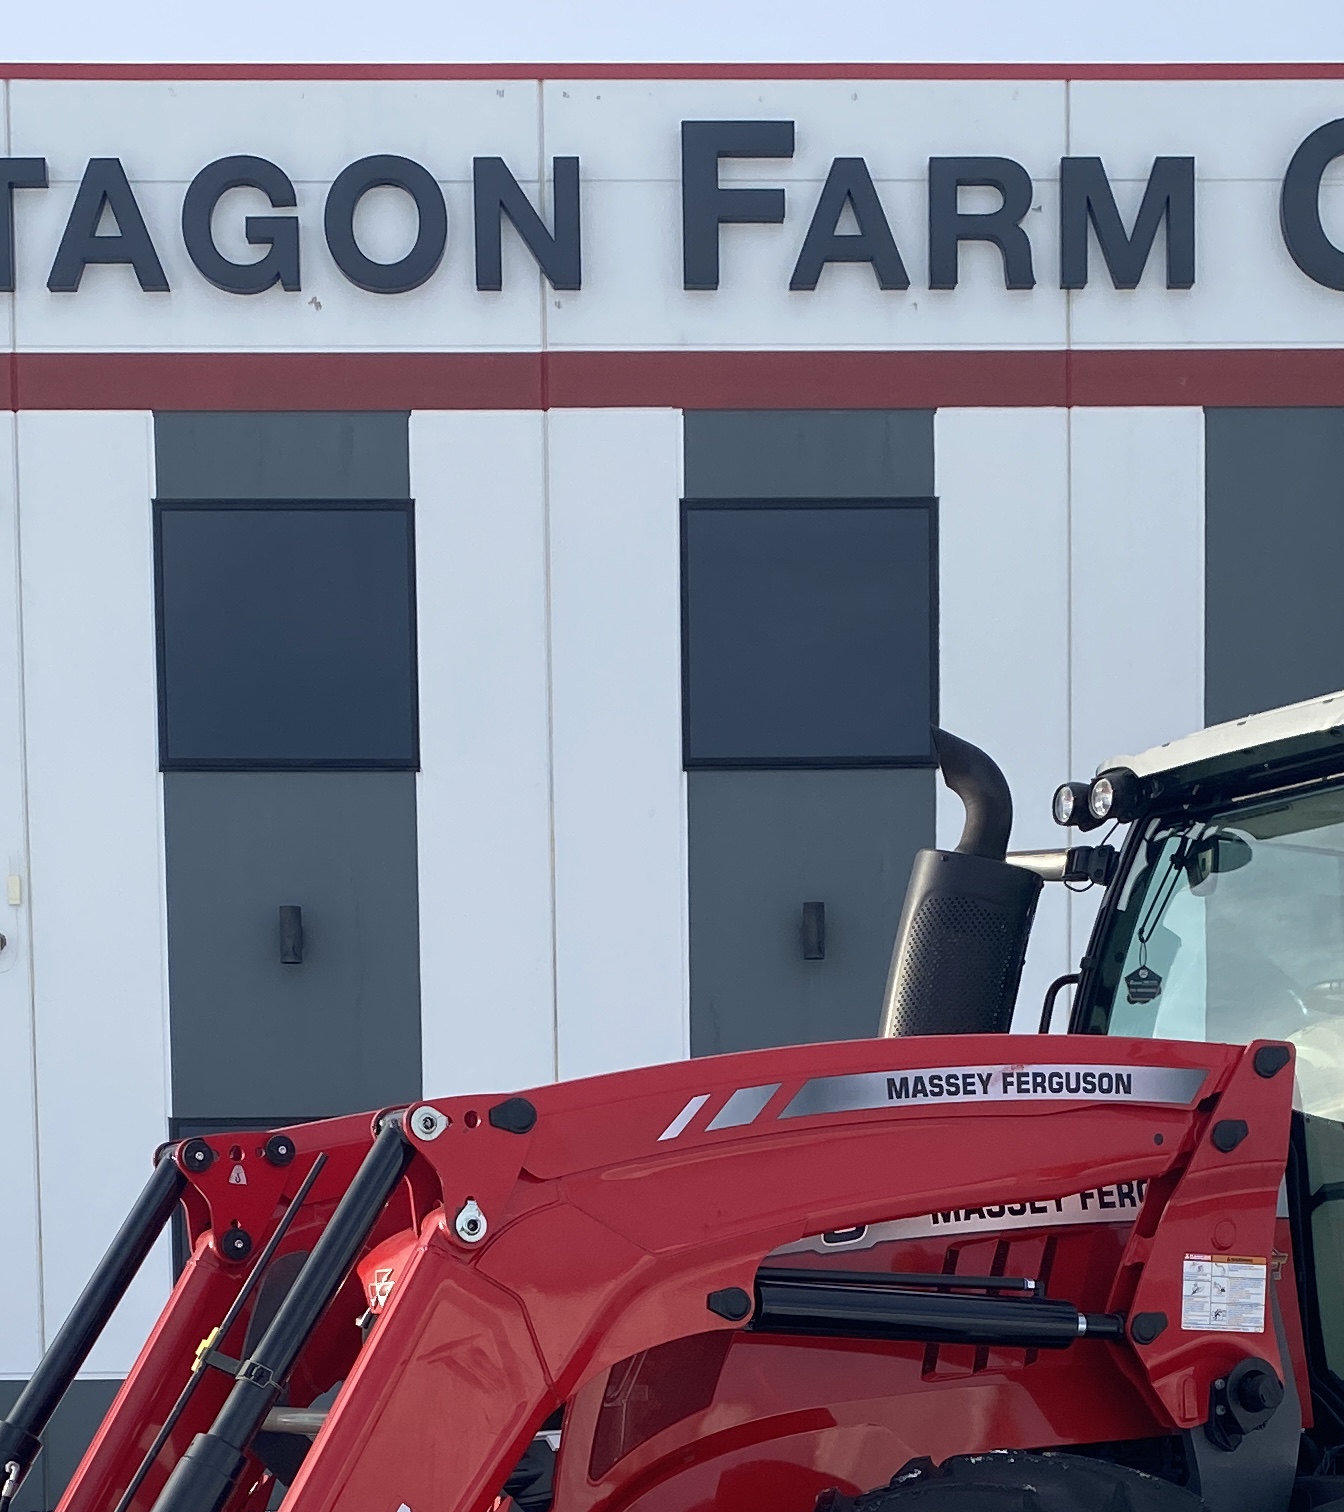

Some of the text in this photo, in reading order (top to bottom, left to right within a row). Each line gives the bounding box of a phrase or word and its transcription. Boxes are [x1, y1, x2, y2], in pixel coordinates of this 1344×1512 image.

[680, 118, 1199, 293] FARM
[886, 1071, 1132, 1100] MASSEY FERGUSON
